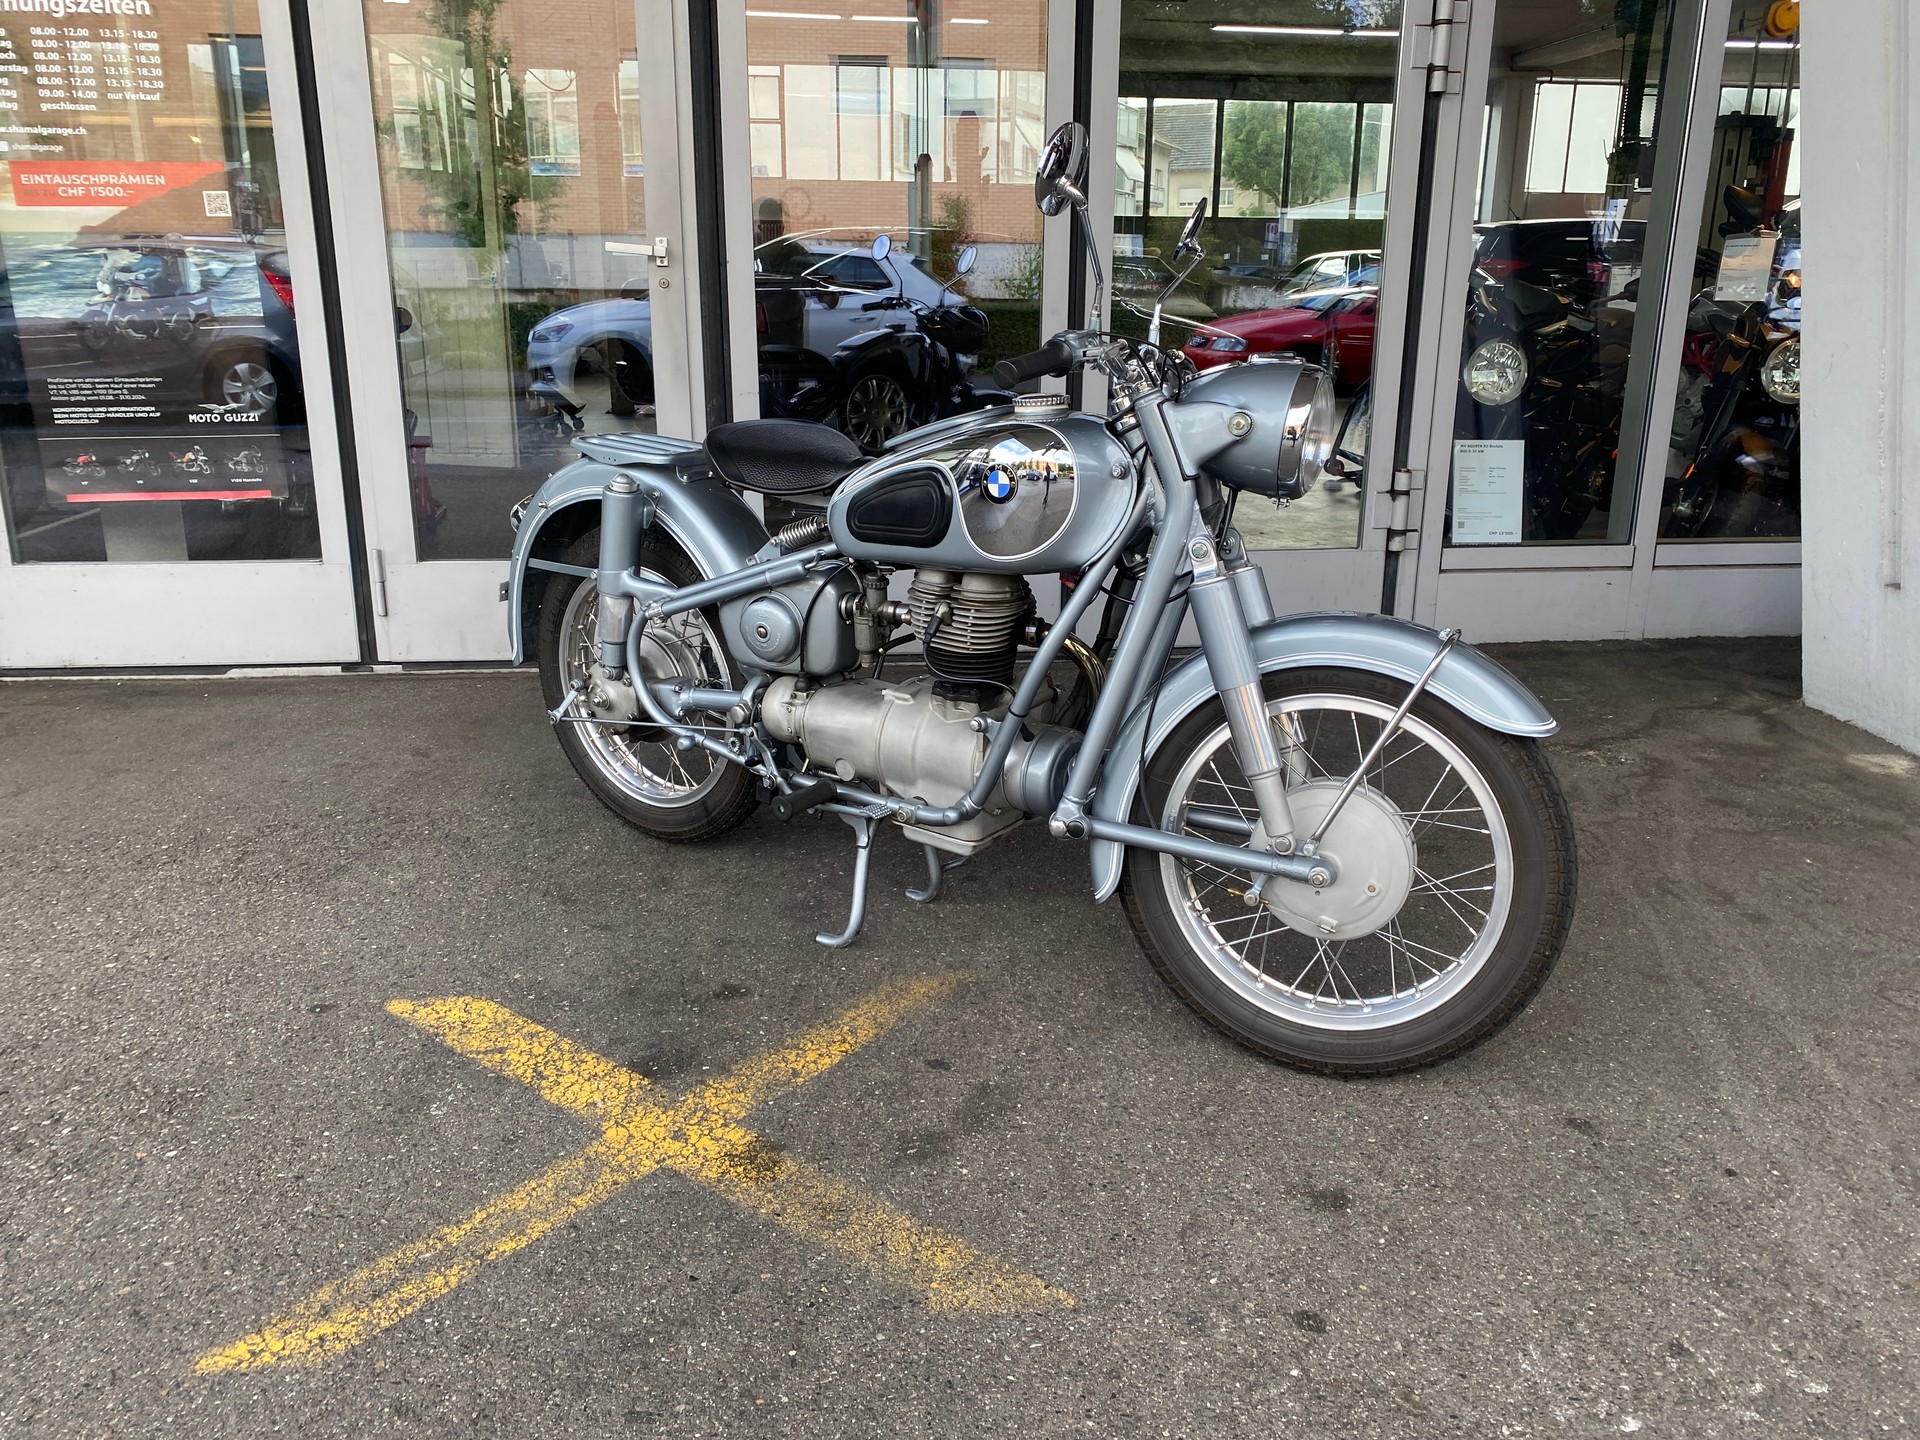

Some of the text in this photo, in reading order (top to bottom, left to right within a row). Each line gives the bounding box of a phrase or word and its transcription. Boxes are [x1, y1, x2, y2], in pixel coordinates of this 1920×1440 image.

[0, 0, 150, 17] nungszeiten
[30, 27, 56, 35] 08.00
[64, 28, 88, 36] 12.00
[99, 29, 124, 37] 13.15
[132, 30, 157, 38] 18.30
[65, 40, 90, 49] 12.00
[33, 52, 59, 60] 08.00
[67, 53, 92, 61] 12.00
[103, 54, 127, 62] 13.15
[135, 55, 160, 64] 18.30
[68, 66, 94, 74] 12.00
[104, 66, 129, 75] 13.15
[137, 68, 162, 76] 18.30
[37, 77, 62, 85] 08.00
[70, 78, 96, 86] 12.00
[106, 79, 130, 87] 13.15
[139, 80, 164, 89] 18.30
[38, 89, 64, 97] 09.00
[72, 90, 97, 99] 14.00
[124, 92, 160, 101] Verkauf
[40, 102, 96, 111] geschlossen
[12, 143, 63, 152] shamalgarage
[20, 172, 165, 185] EINTAUSCHPRÄMIEN
[58, 187, 86, 196] CHF
[188, 413, 259, 422] MOTO GUZZI
